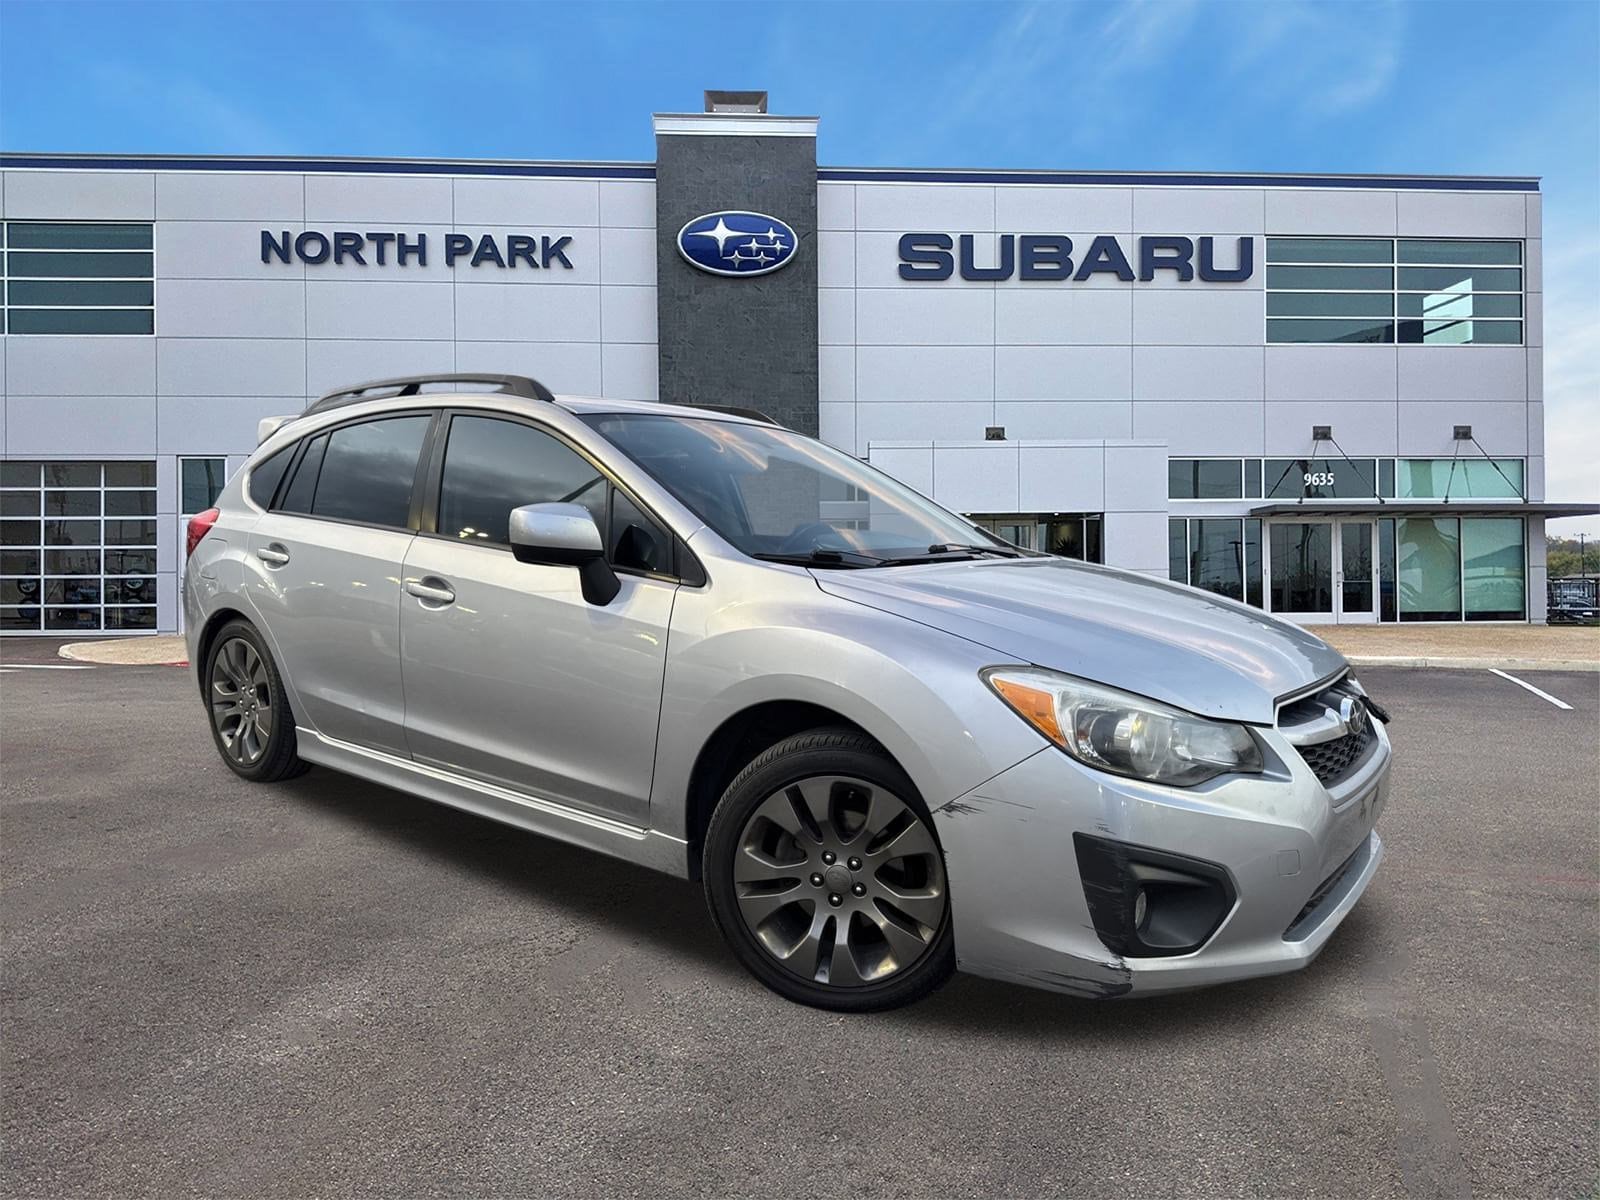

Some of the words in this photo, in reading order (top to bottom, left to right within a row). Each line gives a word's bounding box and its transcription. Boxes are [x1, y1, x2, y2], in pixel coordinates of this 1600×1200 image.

[260, 231, 427, 266] NORTH
[445, 233, 573, 269] PARK
[898, 233, 1254, 281] SUBARU
[1303, 472, 1335, 486] 9635
